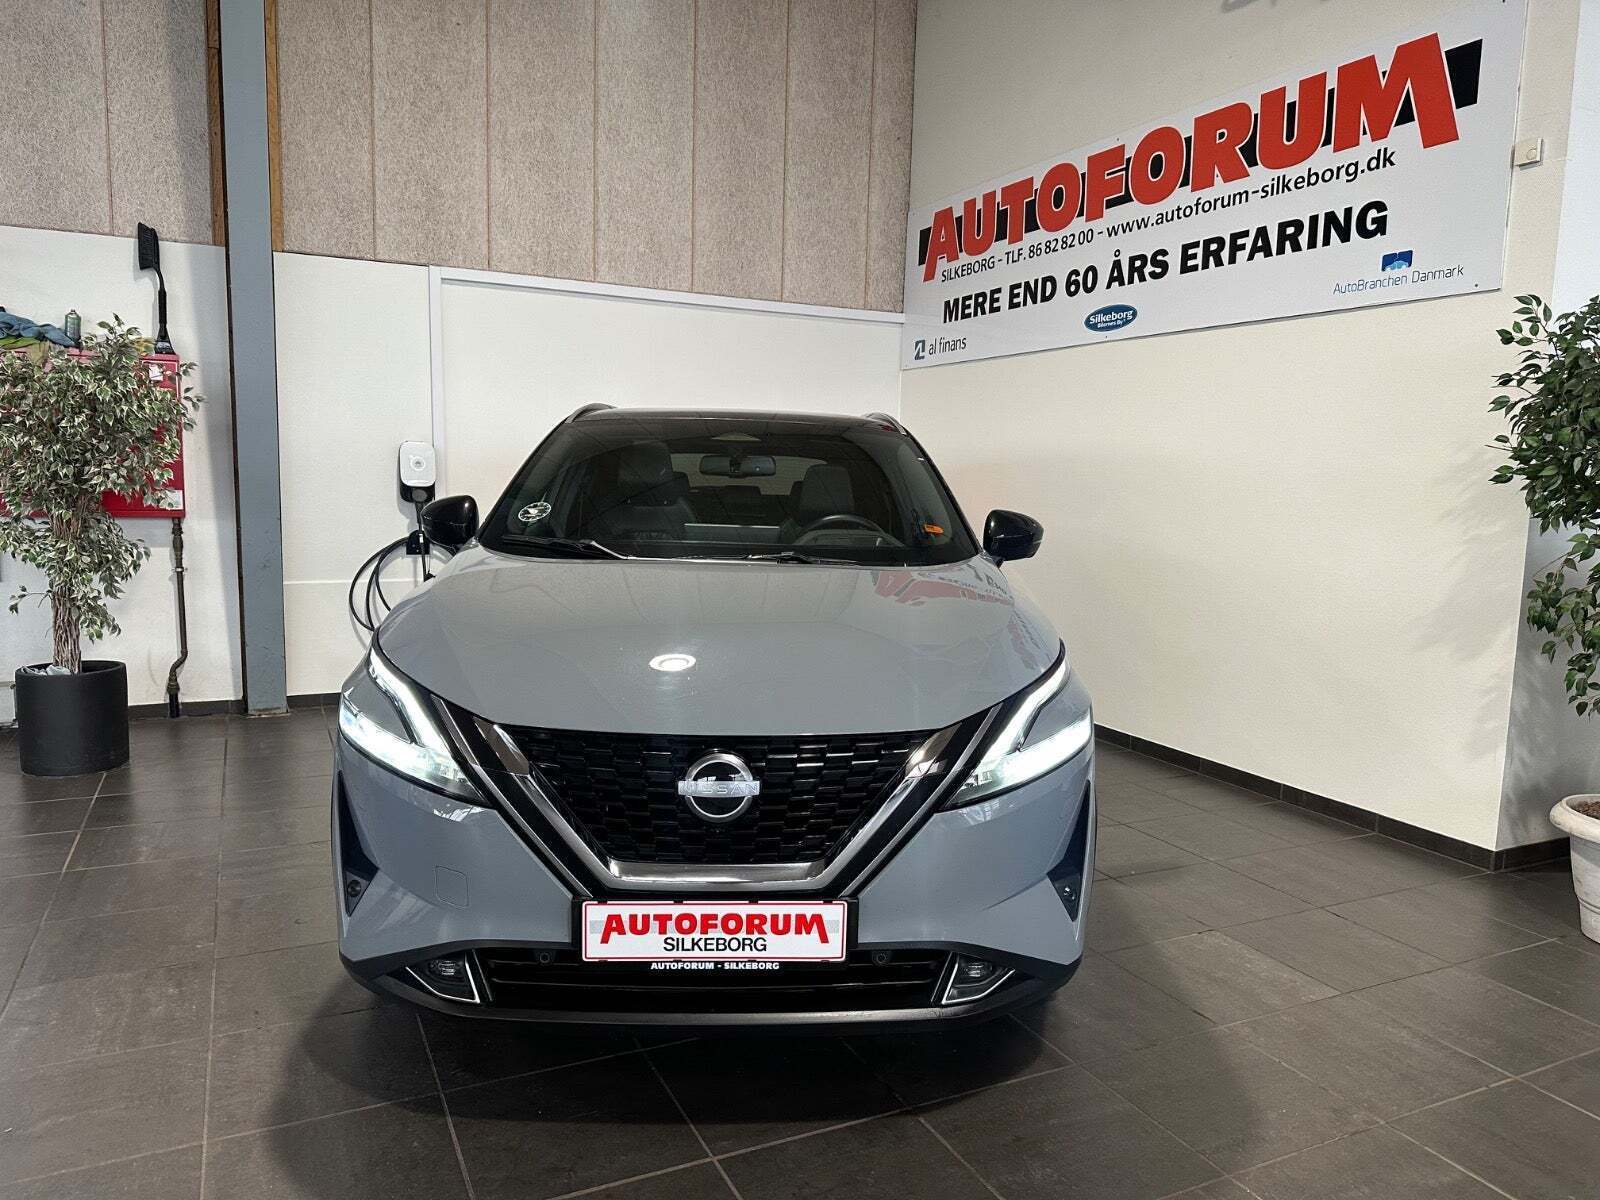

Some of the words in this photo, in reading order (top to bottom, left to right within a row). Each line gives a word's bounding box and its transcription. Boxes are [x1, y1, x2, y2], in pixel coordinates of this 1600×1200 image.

[922, 31, 1460, 284] AUTOFORUM
[941, 255, 995, 283] SILKEBORG
[1005, 247, 1026, 265] TLF.
[1106, 147, 1396, 238] www.autoforum-silkeborg.dk
[942, 286, 1002, 324] MERE
[1007, 275, 1058, 310] END
[1065, 264, 1098, 297] 60
[1105, 248, 1170, 290] ÅRS
[1179, 200, 1389, 275] ERFARING
[1333, 274, 1408, 295] AutoBranchen
[1411, 264, 1464, 283] Danmark
[1089, 310, 1134, 324] Silkeborg
[928, 338, 937, 356] al
[938, 335, 967, 352] finans
[600, 913, 829, 944] AUTOFORUM
[663, 936, 767, 952] SILKEBORG
[650, 962, 715, 970] AUTOFORUM
[723, 962, 780, 970] SILKEBORG
